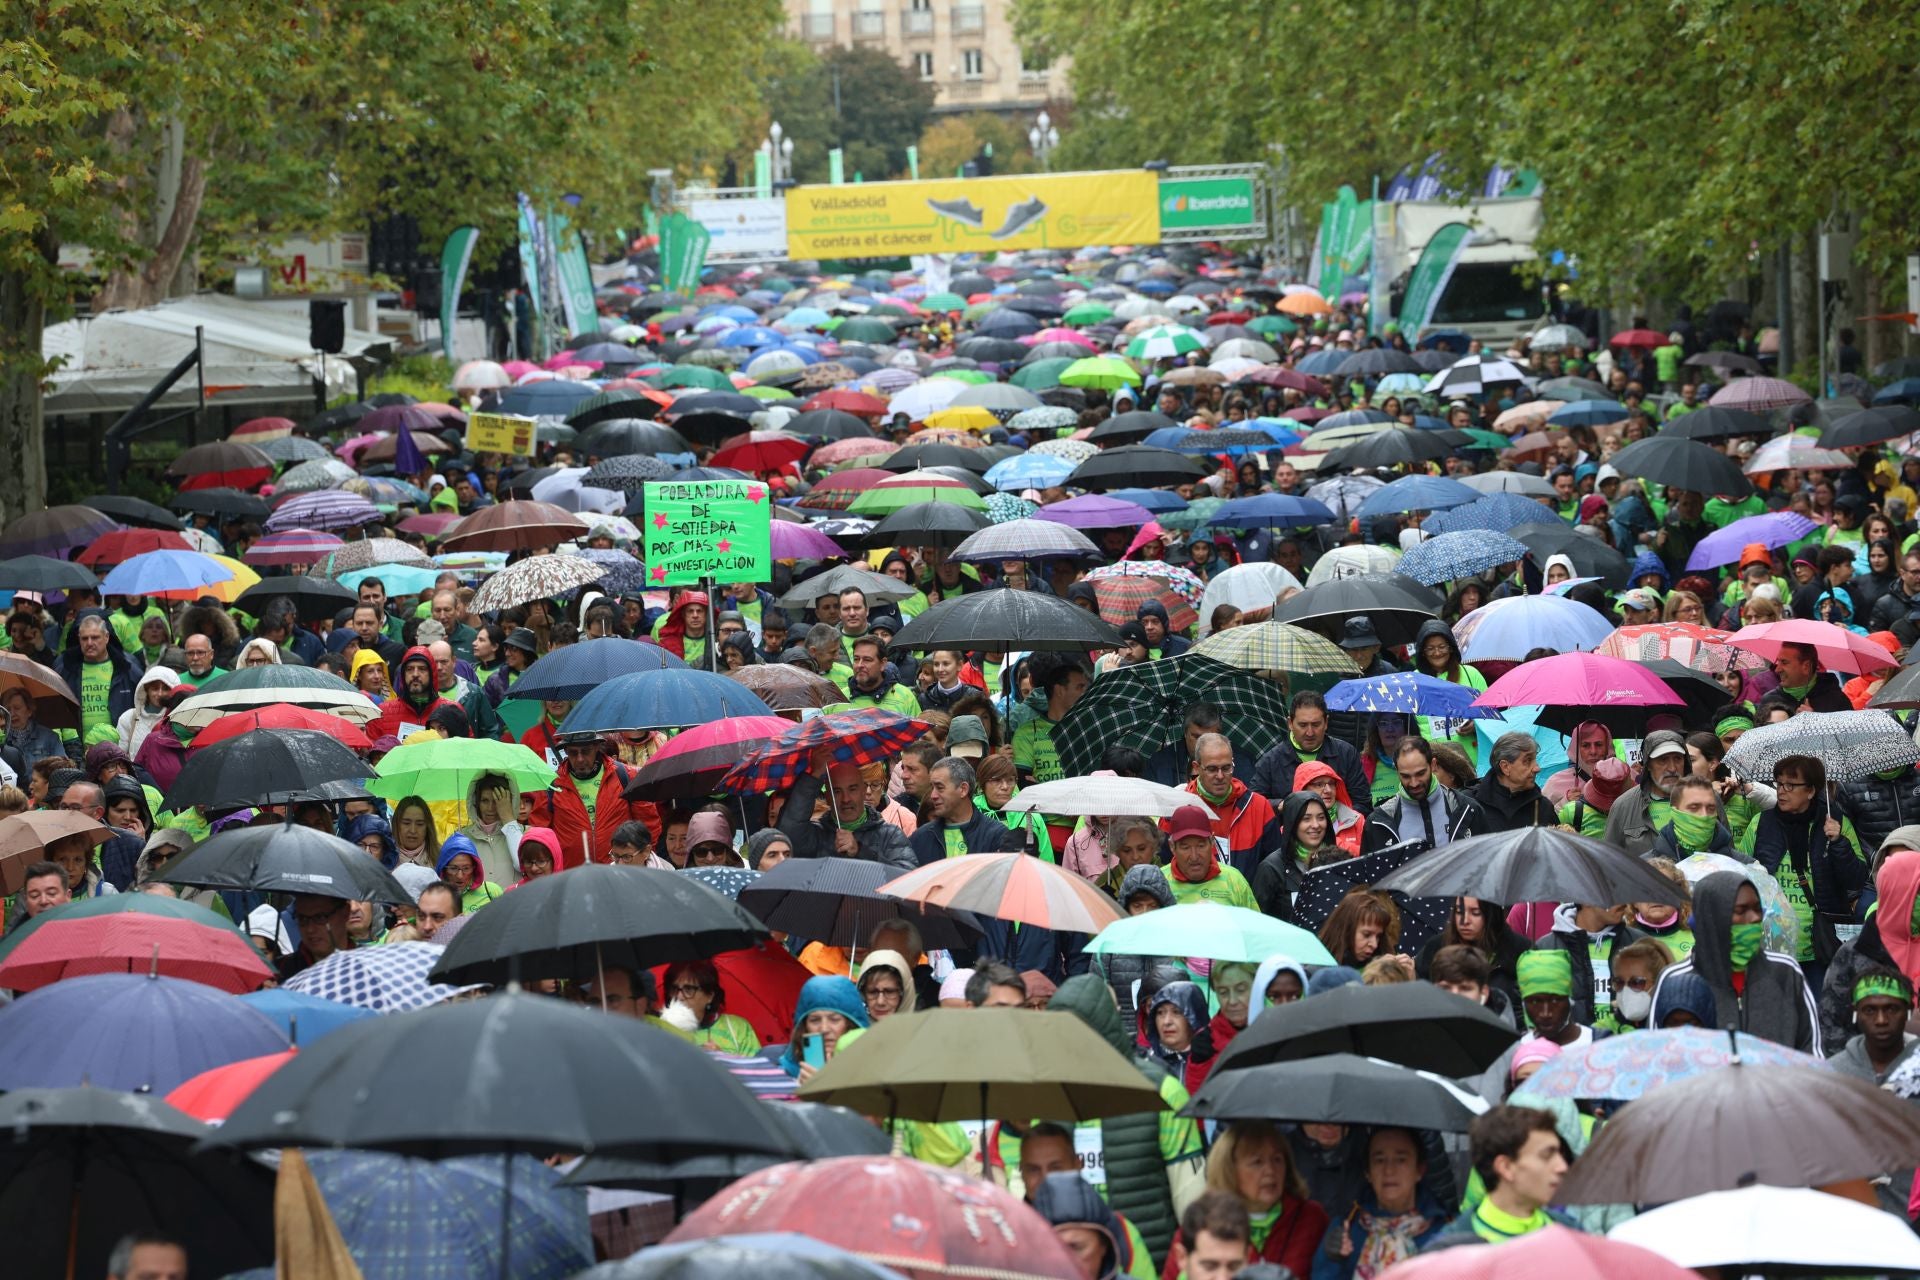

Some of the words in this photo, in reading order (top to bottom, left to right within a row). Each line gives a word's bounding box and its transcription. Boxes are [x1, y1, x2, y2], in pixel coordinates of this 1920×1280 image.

[811, 195, 886, 210] Valladolid
[1188, 194, 1249, 211] Iberdrola
[811, 216, 830, 226] en
[834, 211, 891, 225] marcha
[812, 234, 861, 249] contra
[865, 232, 879, 247] el
[660, 484, 745, 501] POBLADURA
[692, 504, 711, 518] DE
[672, 521, 737, 537] SOTIEDRA
[652, 542, 678, 556] POR
